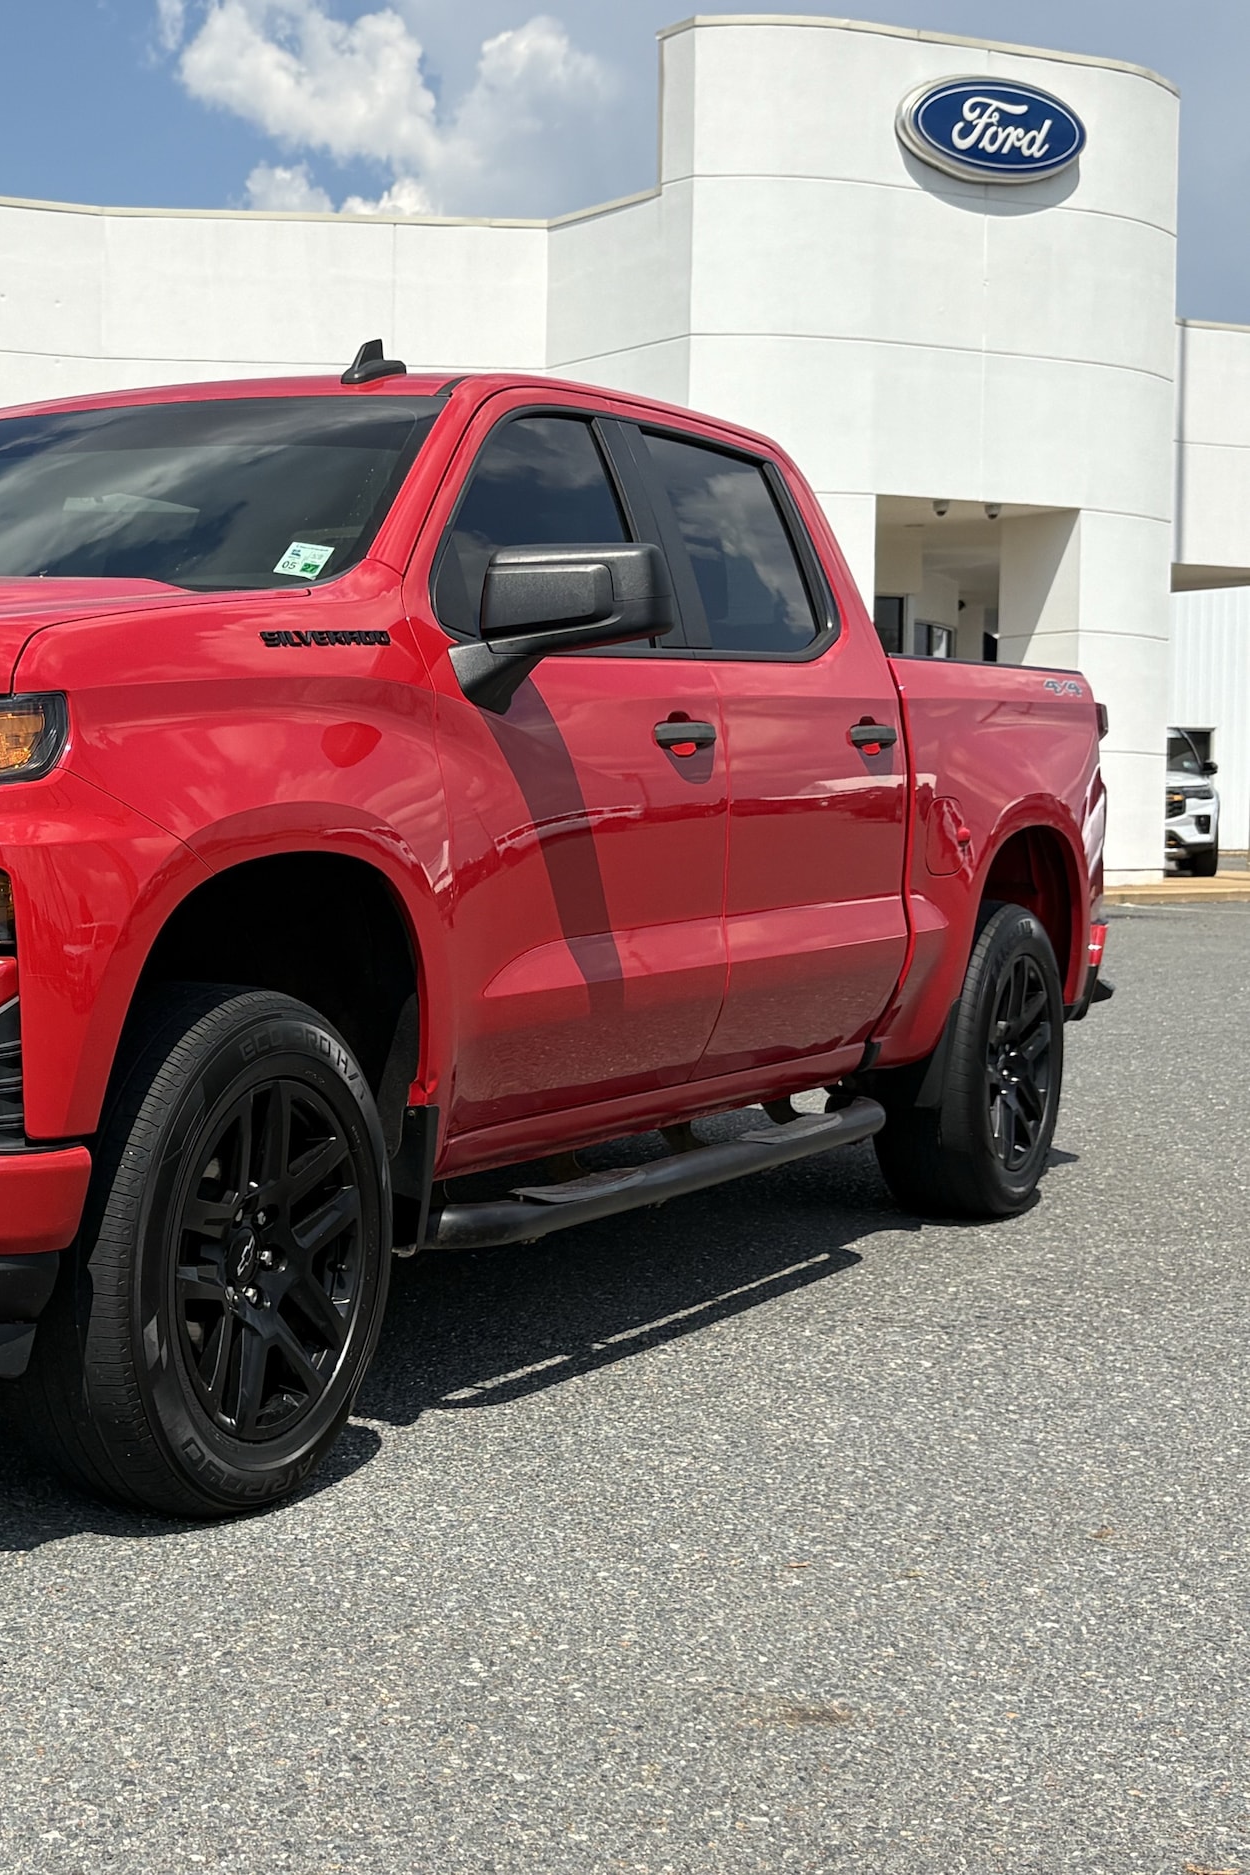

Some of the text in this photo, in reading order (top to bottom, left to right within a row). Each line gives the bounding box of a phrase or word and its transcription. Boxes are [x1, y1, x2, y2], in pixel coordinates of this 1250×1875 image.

[952, 97, 1052, 158] Ford
[281, 560, 297, 570] 05
[302, 563, 319, 573] 27
[260, 631, 391, 648] SILVERADO
